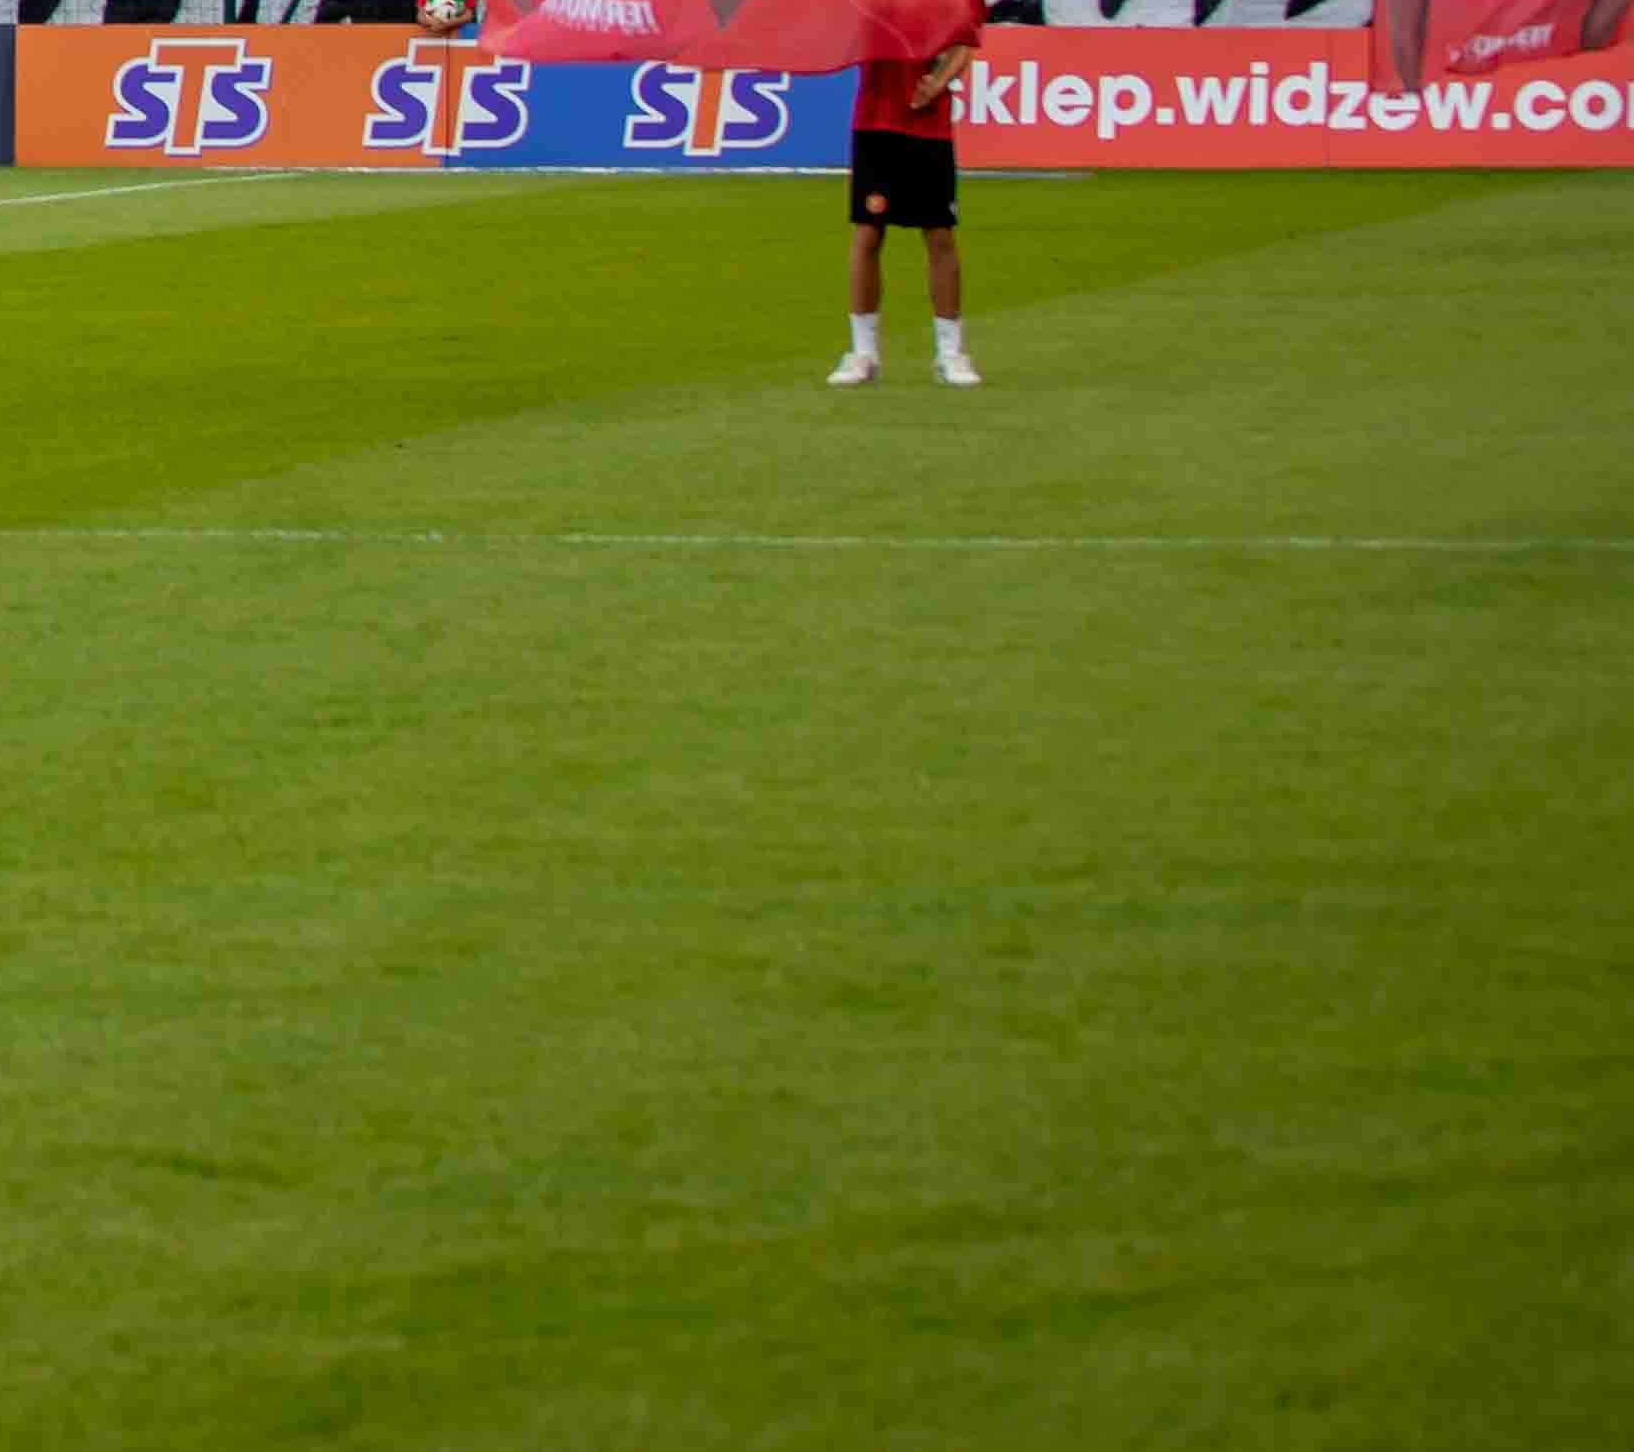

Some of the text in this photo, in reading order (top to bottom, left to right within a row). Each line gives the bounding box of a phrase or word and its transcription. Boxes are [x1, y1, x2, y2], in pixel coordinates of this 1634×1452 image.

[105, 38, 273, 155] STS
[361, 38, 531, 156] STS
[622, 61, 790, 156] STS
[947, 59, 1634, 140] klep.widzew.co
